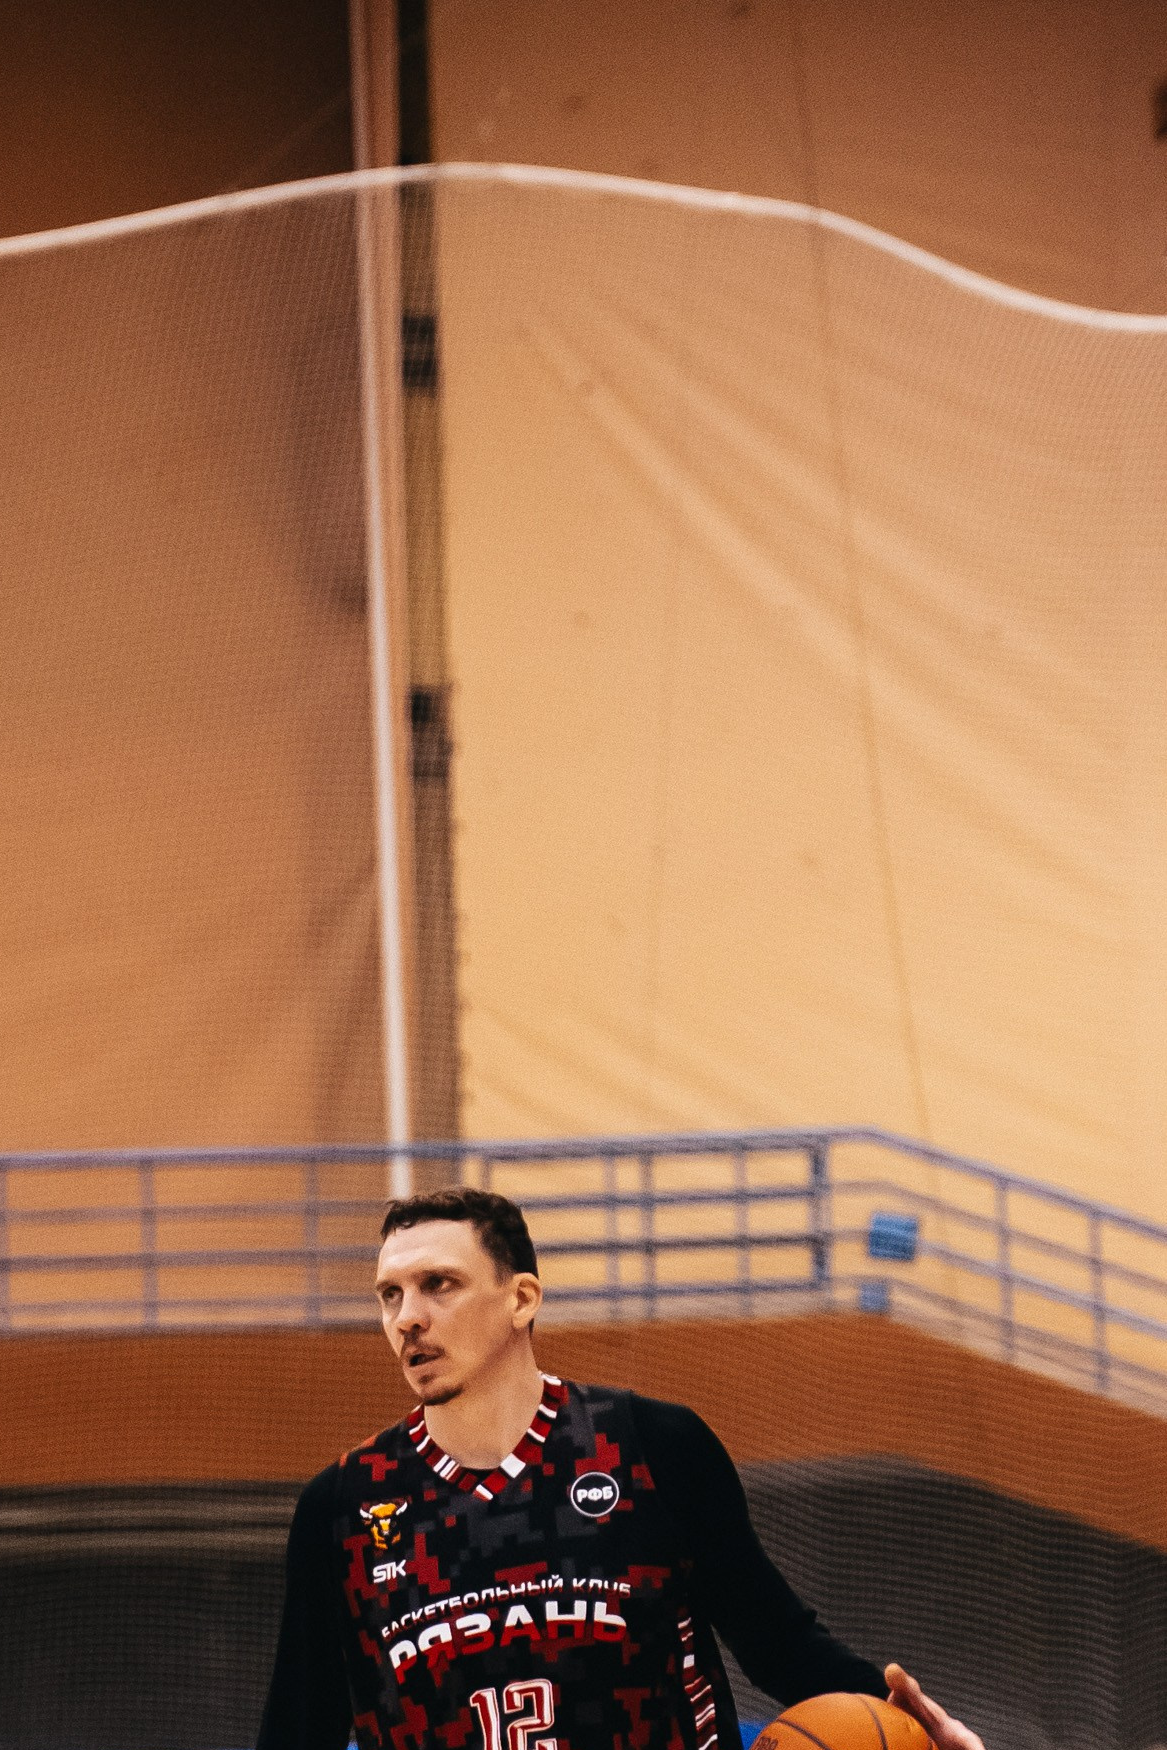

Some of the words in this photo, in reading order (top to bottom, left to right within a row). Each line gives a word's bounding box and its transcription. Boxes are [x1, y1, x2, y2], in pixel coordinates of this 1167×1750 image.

[577, 1486, 613, 1503] РФБ
[373, 1560, 406, 1583] STK
[389, 1600, 627, 1684] РЯЗАНЬ
